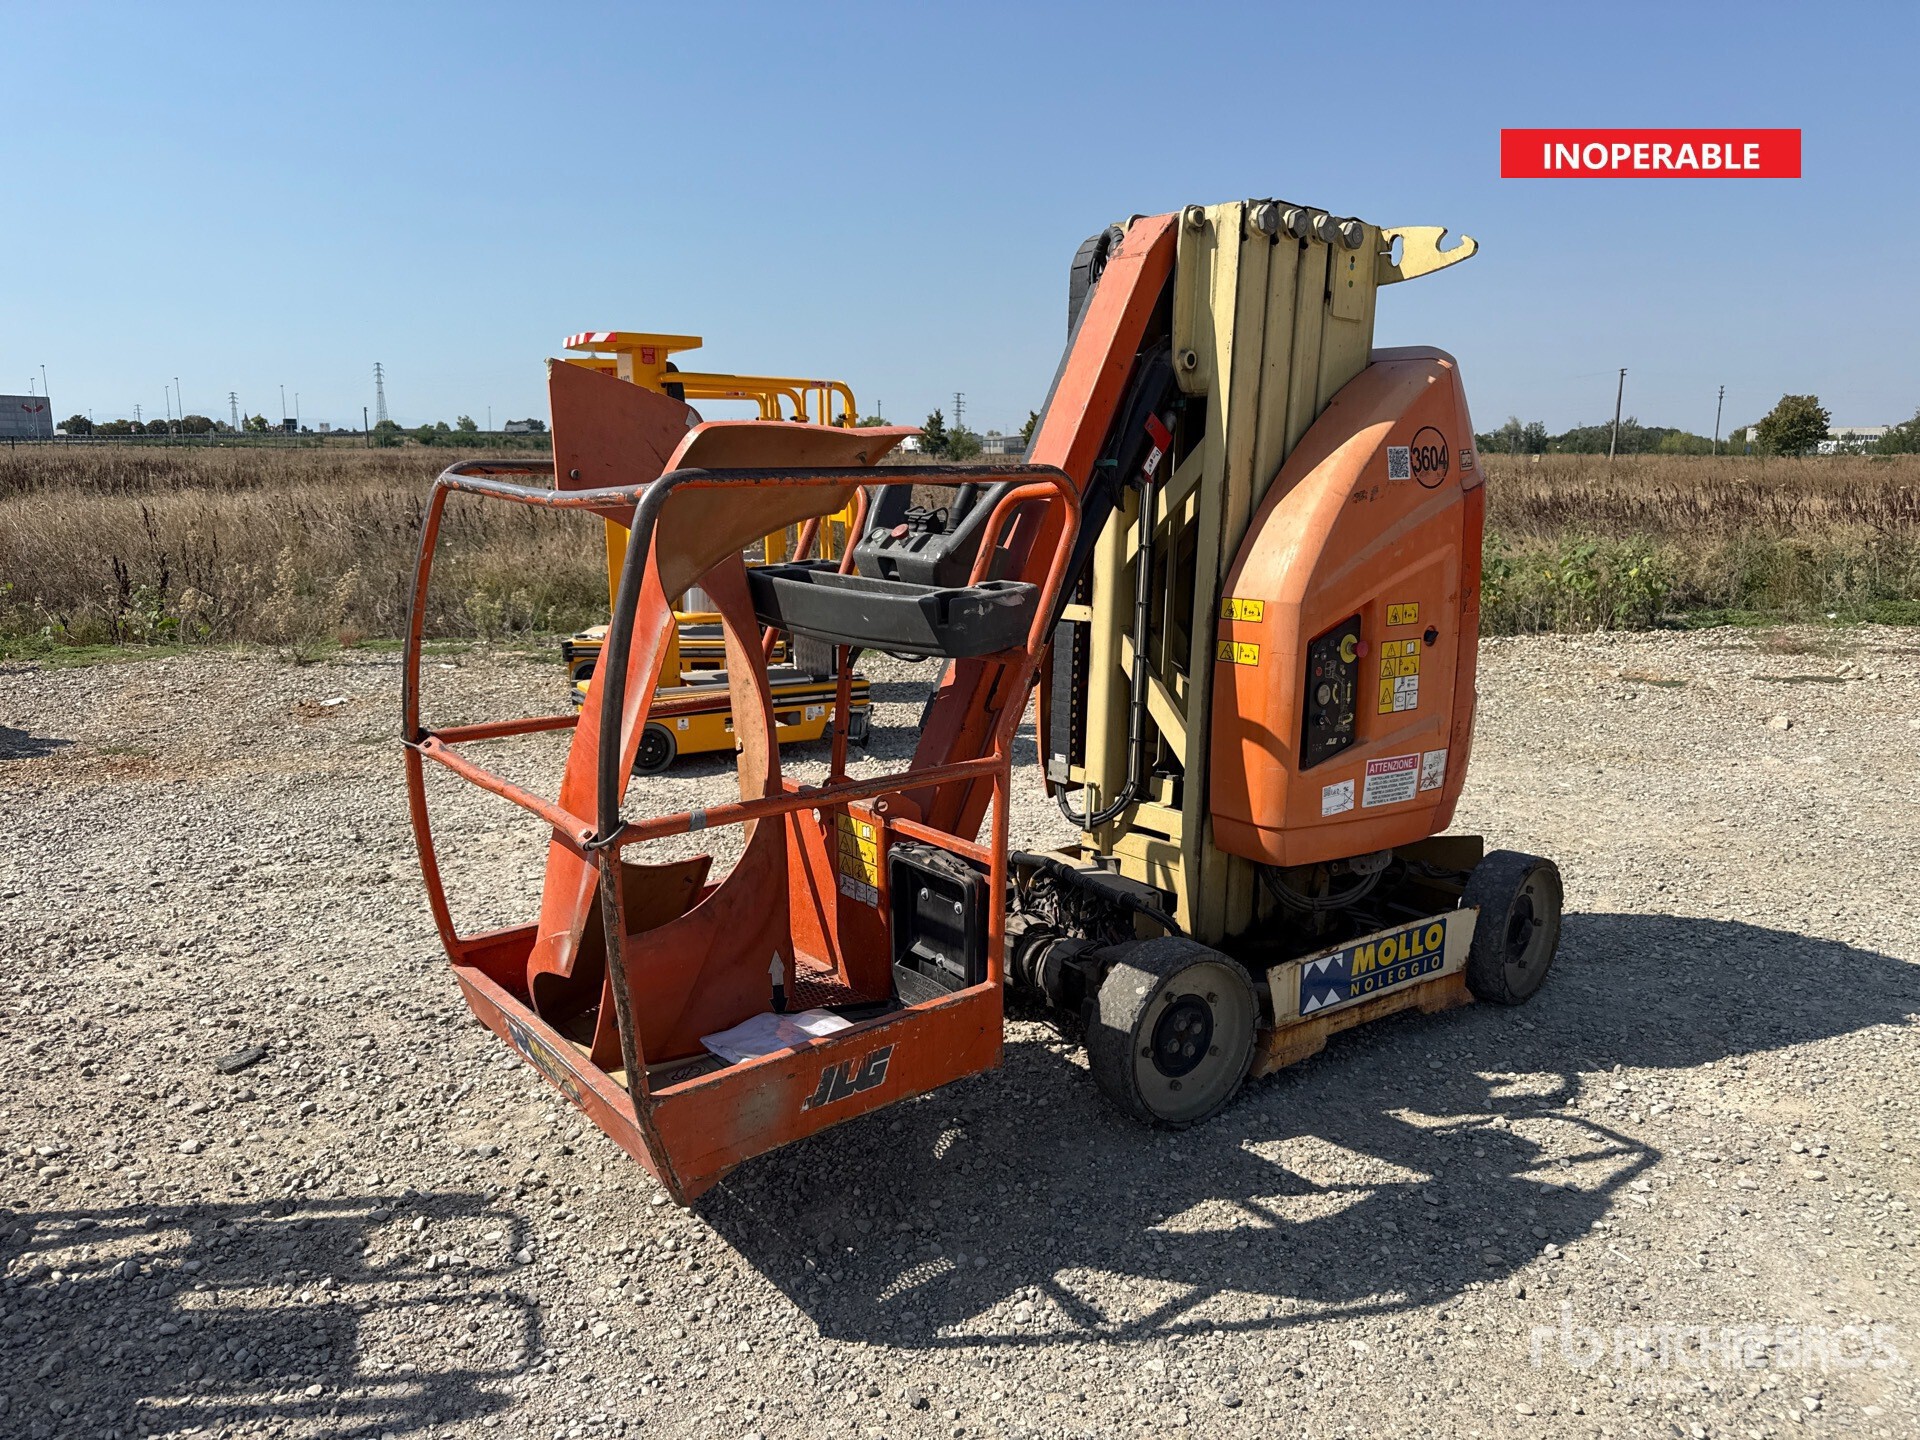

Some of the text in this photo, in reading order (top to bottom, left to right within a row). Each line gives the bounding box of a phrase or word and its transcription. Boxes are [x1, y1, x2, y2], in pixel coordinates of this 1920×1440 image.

[1412, 445, 1447, 472] 3604
[1351, 923, 1444, 976] MOLLO
[1350, 955, 1440, 997] NOLEGGIO
[801, 1043, 895, 1114] JLG
